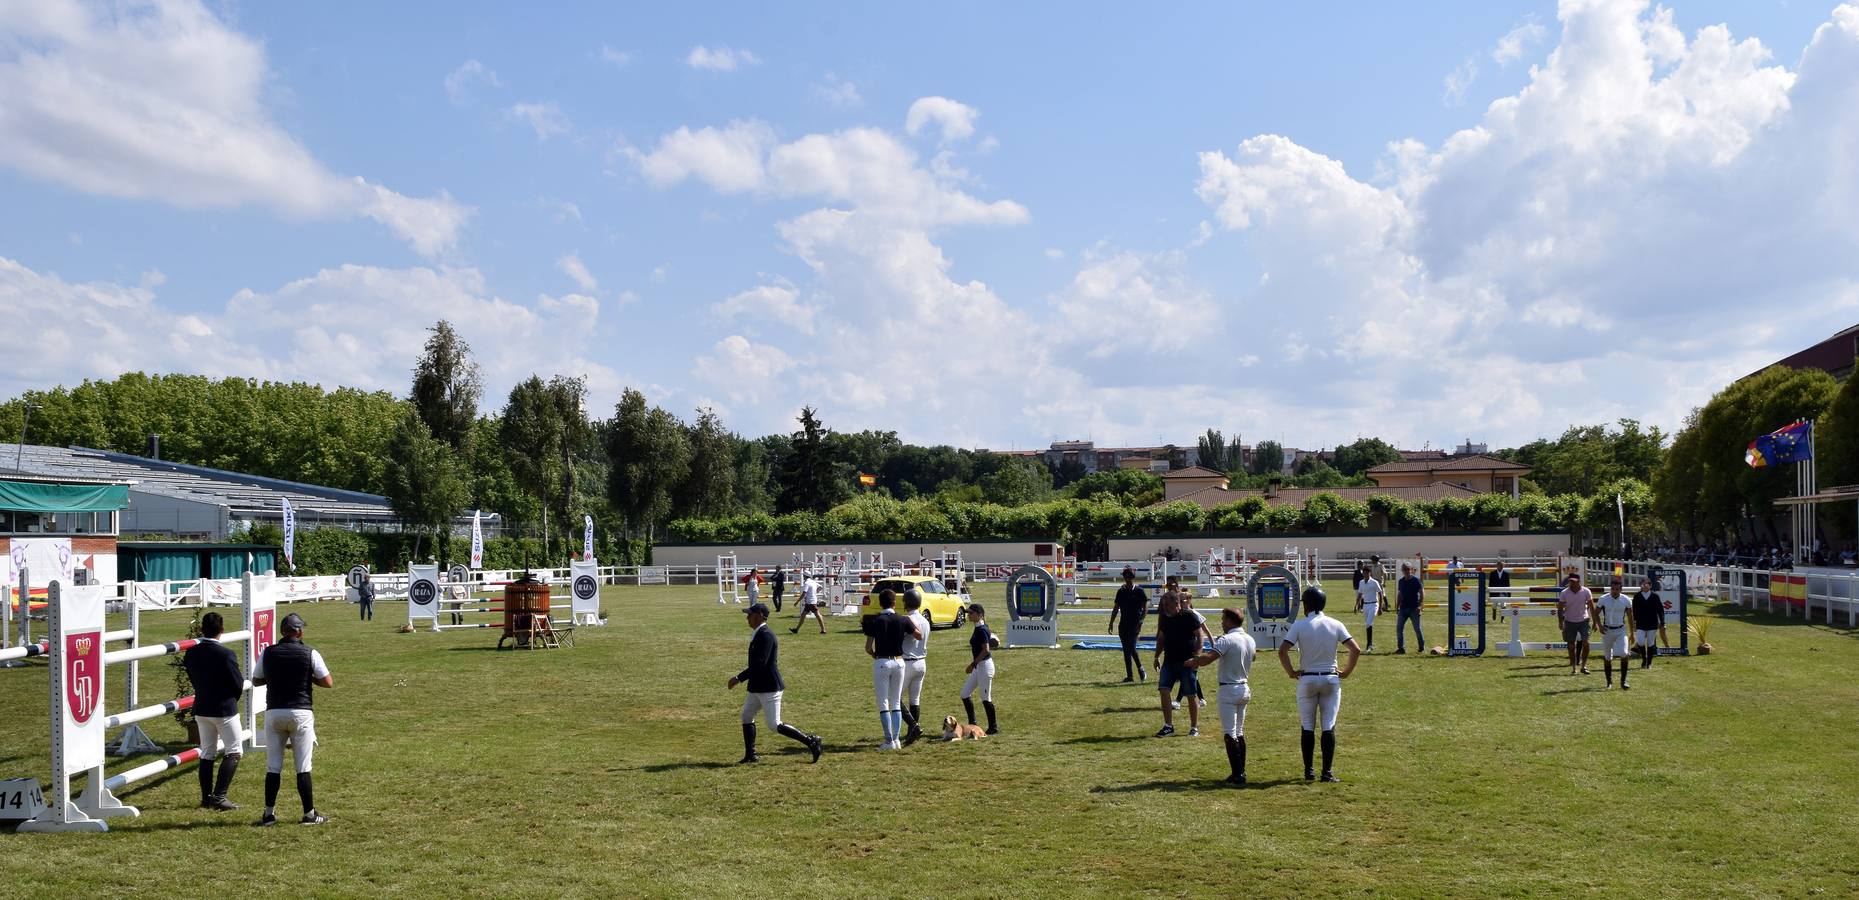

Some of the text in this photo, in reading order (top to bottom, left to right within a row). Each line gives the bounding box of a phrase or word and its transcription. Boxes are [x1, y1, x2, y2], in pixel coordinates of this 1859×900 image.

[1012, 624, 1051, 632] LOGROÑO
[1269, 625, 1277, 633] 7
[1458, 641, 1467, 649] 11
[0, 791, 23, 809] 14
[29, 788, 43, 807] 14
